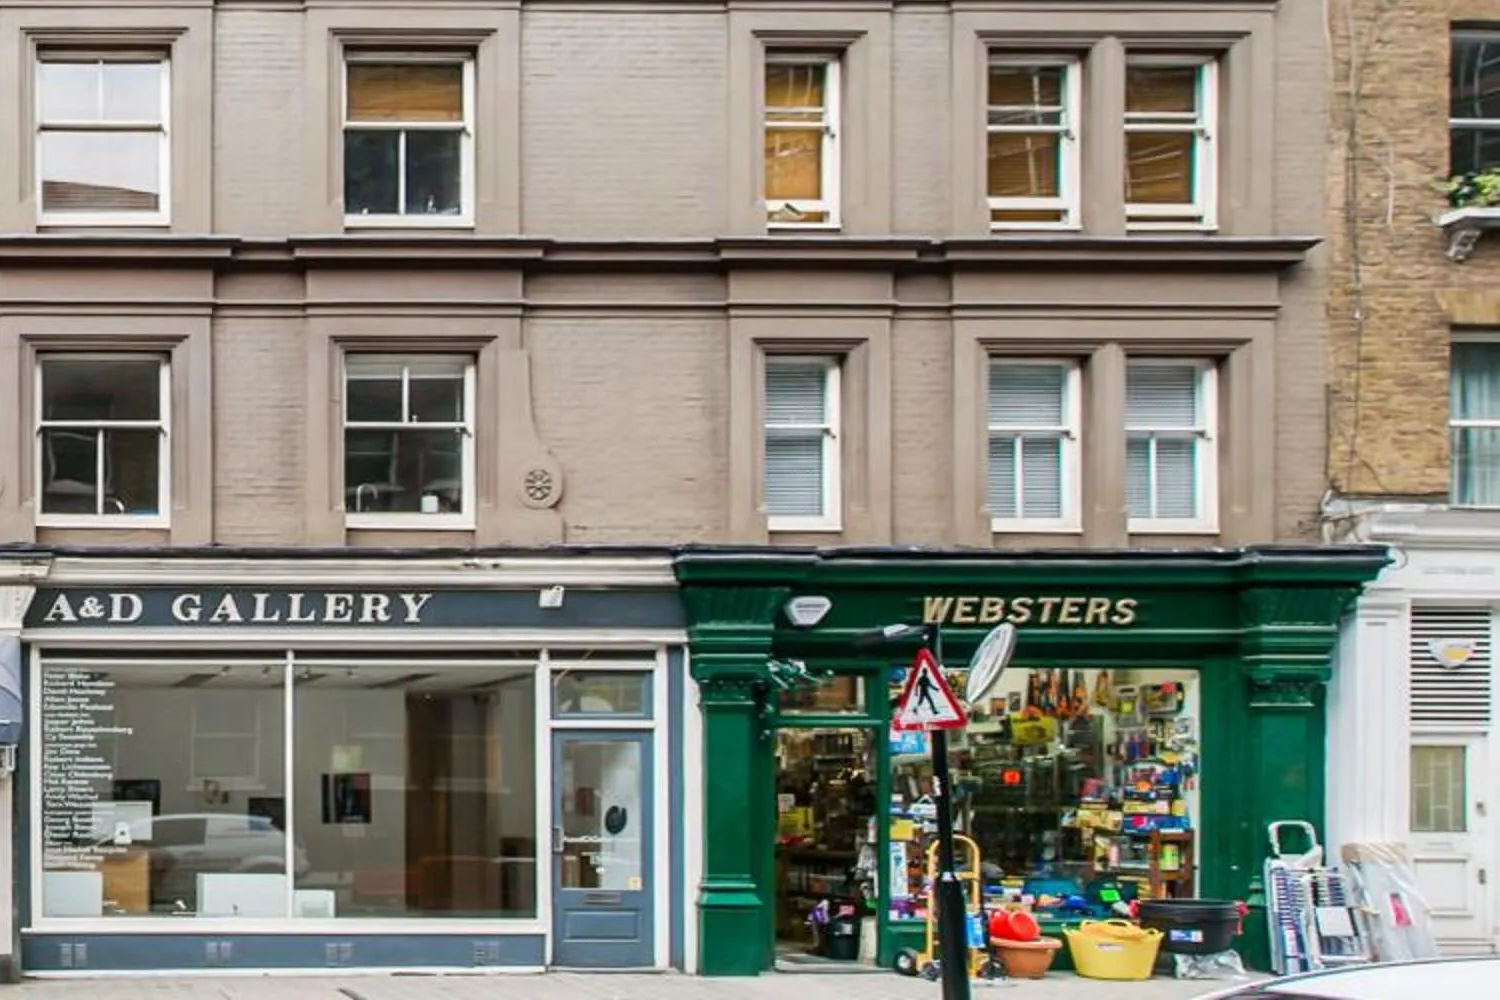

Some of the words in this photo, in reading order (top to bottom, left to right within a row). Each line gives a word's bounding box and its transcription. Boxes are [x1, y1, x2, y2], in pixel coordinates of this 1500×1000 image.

[43, 592, 144, 623] A&D
[171, 592, 433, 623] GALLERY
[923, 596, 1139, 625] WEBSTERS
